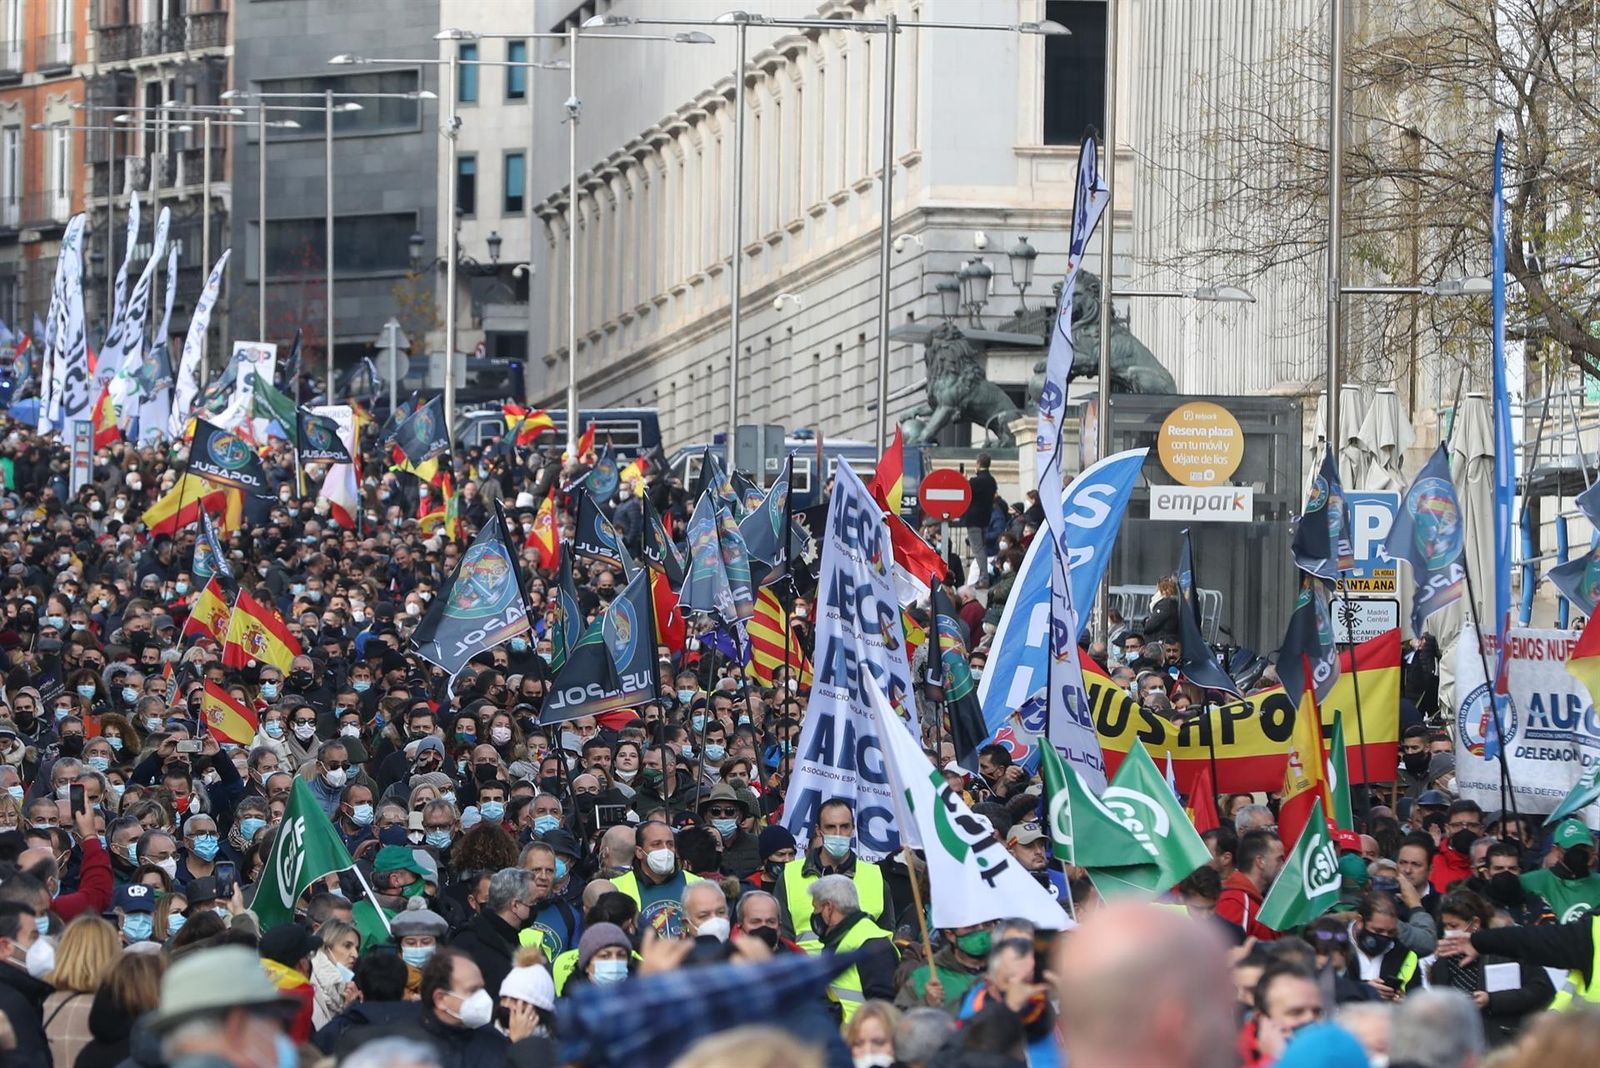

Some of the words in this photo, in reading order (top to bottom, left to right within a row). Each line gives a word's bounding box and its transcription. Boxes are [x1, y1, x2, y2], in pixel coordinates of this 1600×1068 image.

[1168, 425, 1208, 436] Reserva
[1208, 425, 1233, 438] plaza
[1171, 442, 1187, 450] con
[1188, 441, 1199, 450] tu
[1222, 443, 1230, 453] y
[1201, 454, 1212, 464] de
[190, 459, 261, 487] JUSAPOL
[1157, 491, 1246, 515] empark
[1353, 504, 1394, 561] P
[1373, 580, 1395, 591] ANA
[127, 885, 148, 898] CEP
